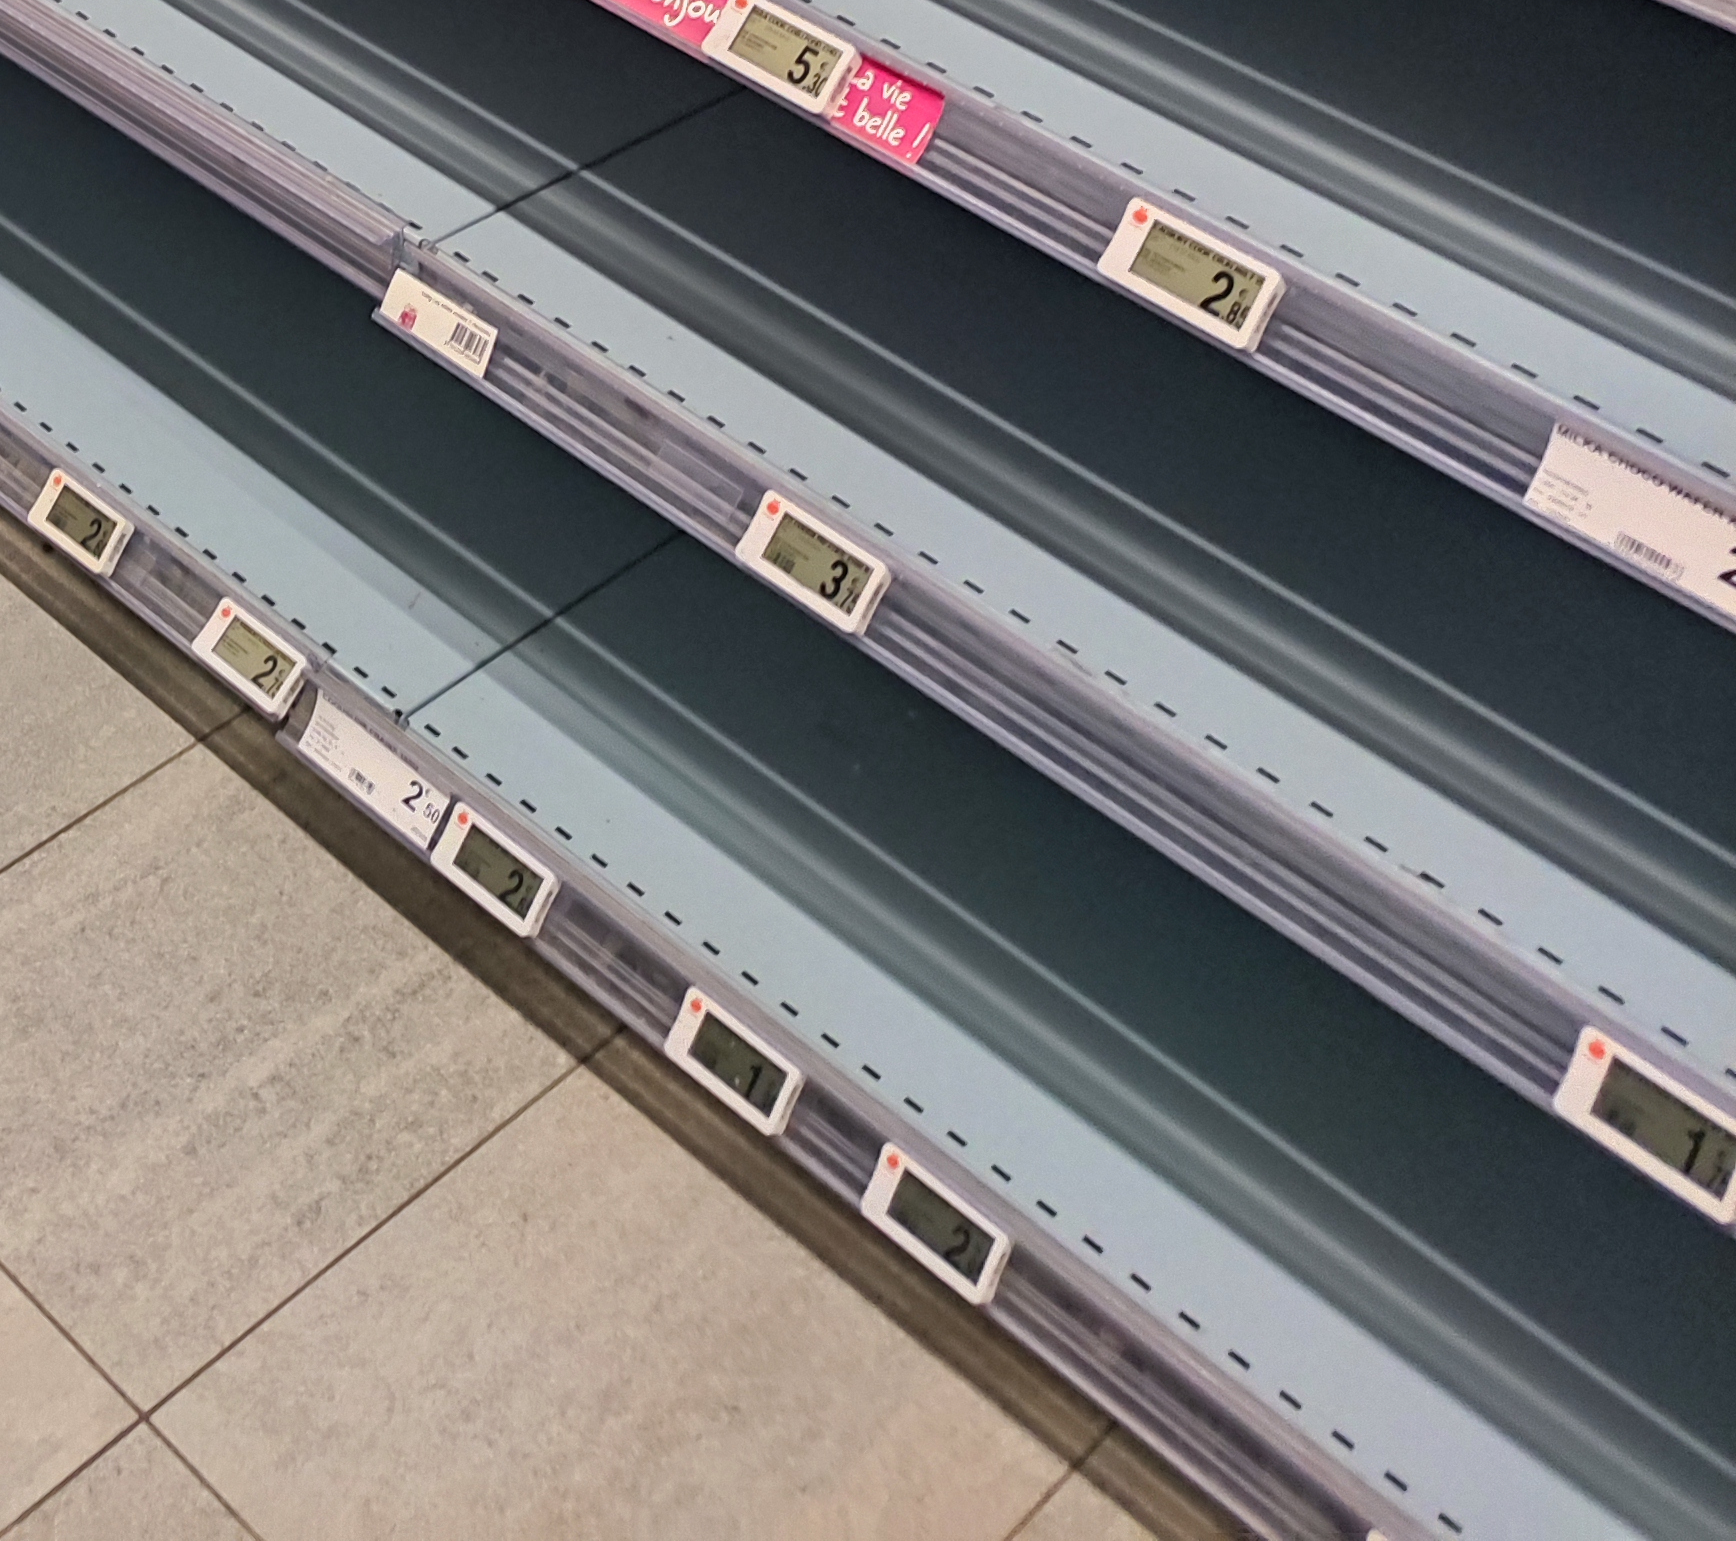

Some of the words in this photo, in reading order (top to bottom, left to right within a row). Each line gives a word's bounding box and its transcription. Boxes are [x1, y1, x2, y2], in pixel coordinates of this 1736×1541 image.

[883, 80, 912, 111] vie
[852, 98, 906, 147] belle
[80, 517, 103, 546] 2
[497, 868, 524, 903] 2
[746, 1064, 763, 1099] 1
[1684, 1127, 1707, 1174] 1
[944, 1226, 970, 1261] 2
